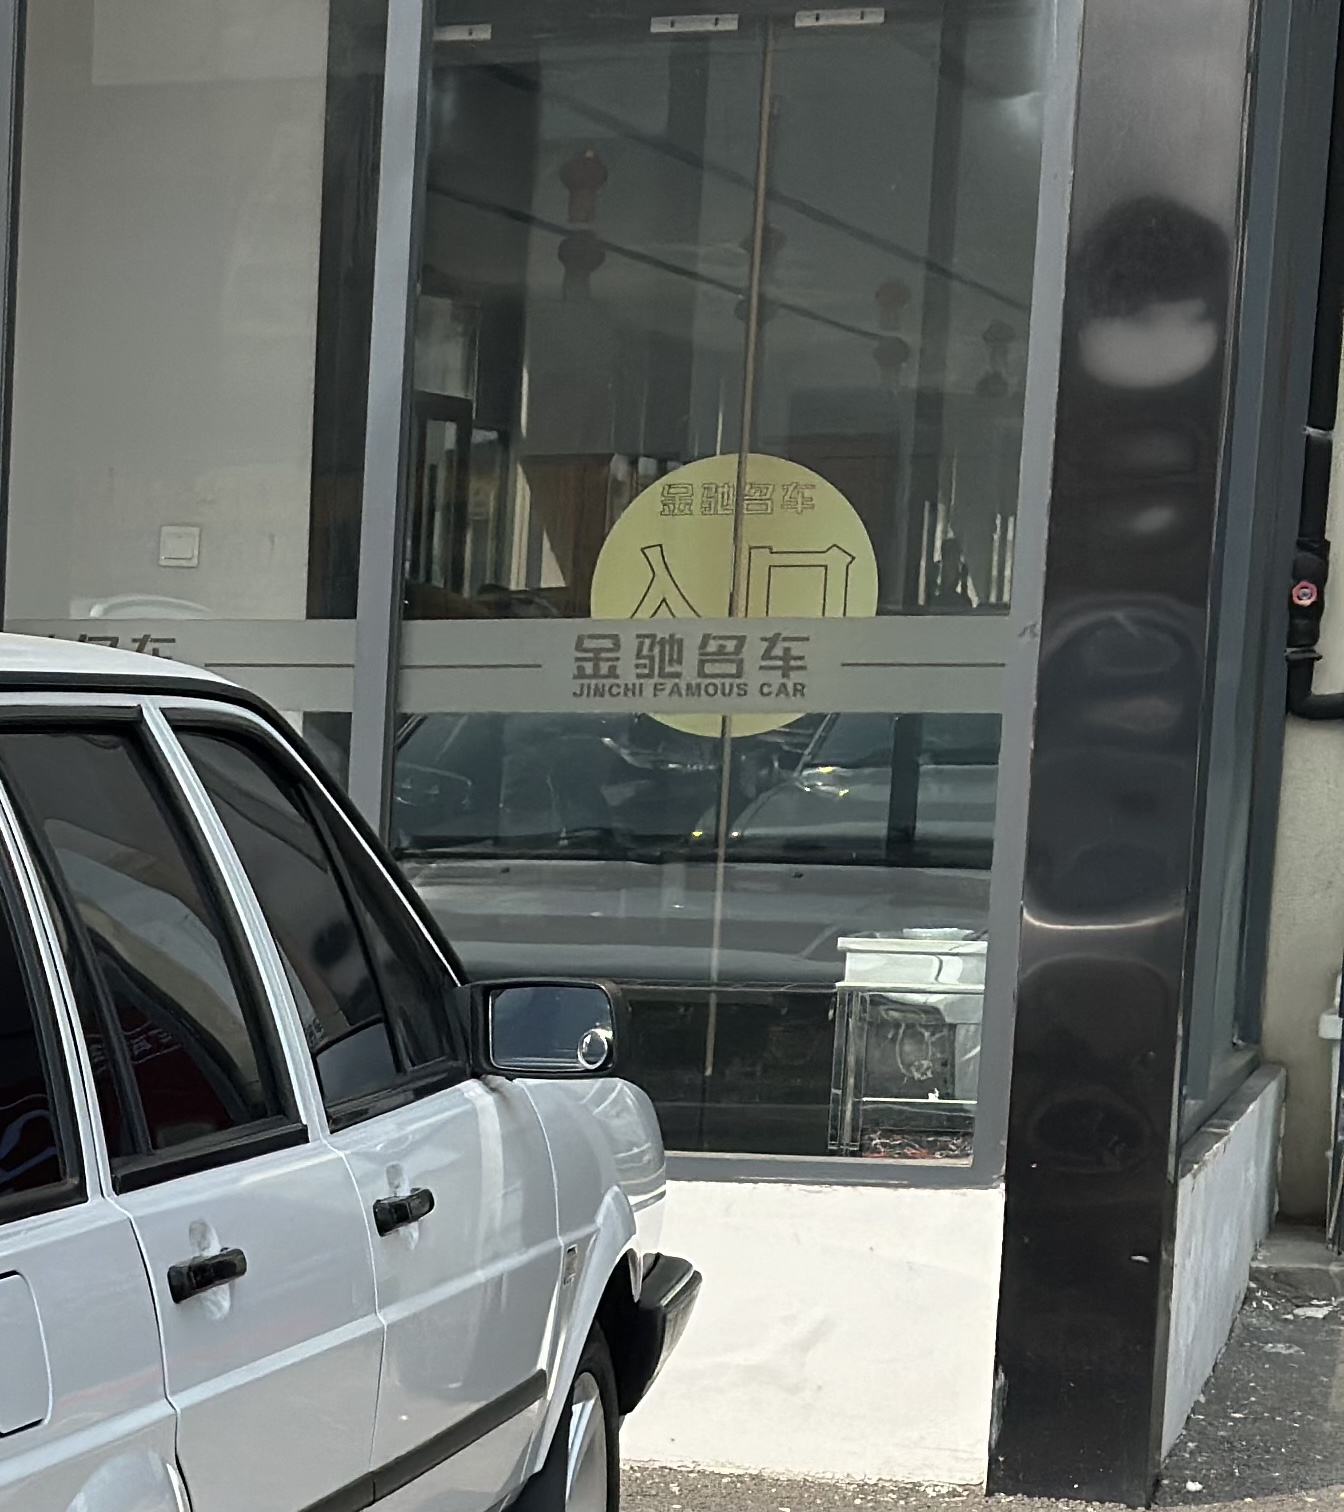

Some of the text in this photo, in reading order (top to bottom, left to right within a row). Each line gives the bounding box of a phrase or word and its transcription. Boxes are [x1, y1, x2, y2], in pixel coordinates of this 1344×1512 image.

[660, 482, 816, 515] 金驰名车
[572, 632, 810, 679] 金驰名车
[572, 681, 807, 698] JINCHI FAMOUS CAR
